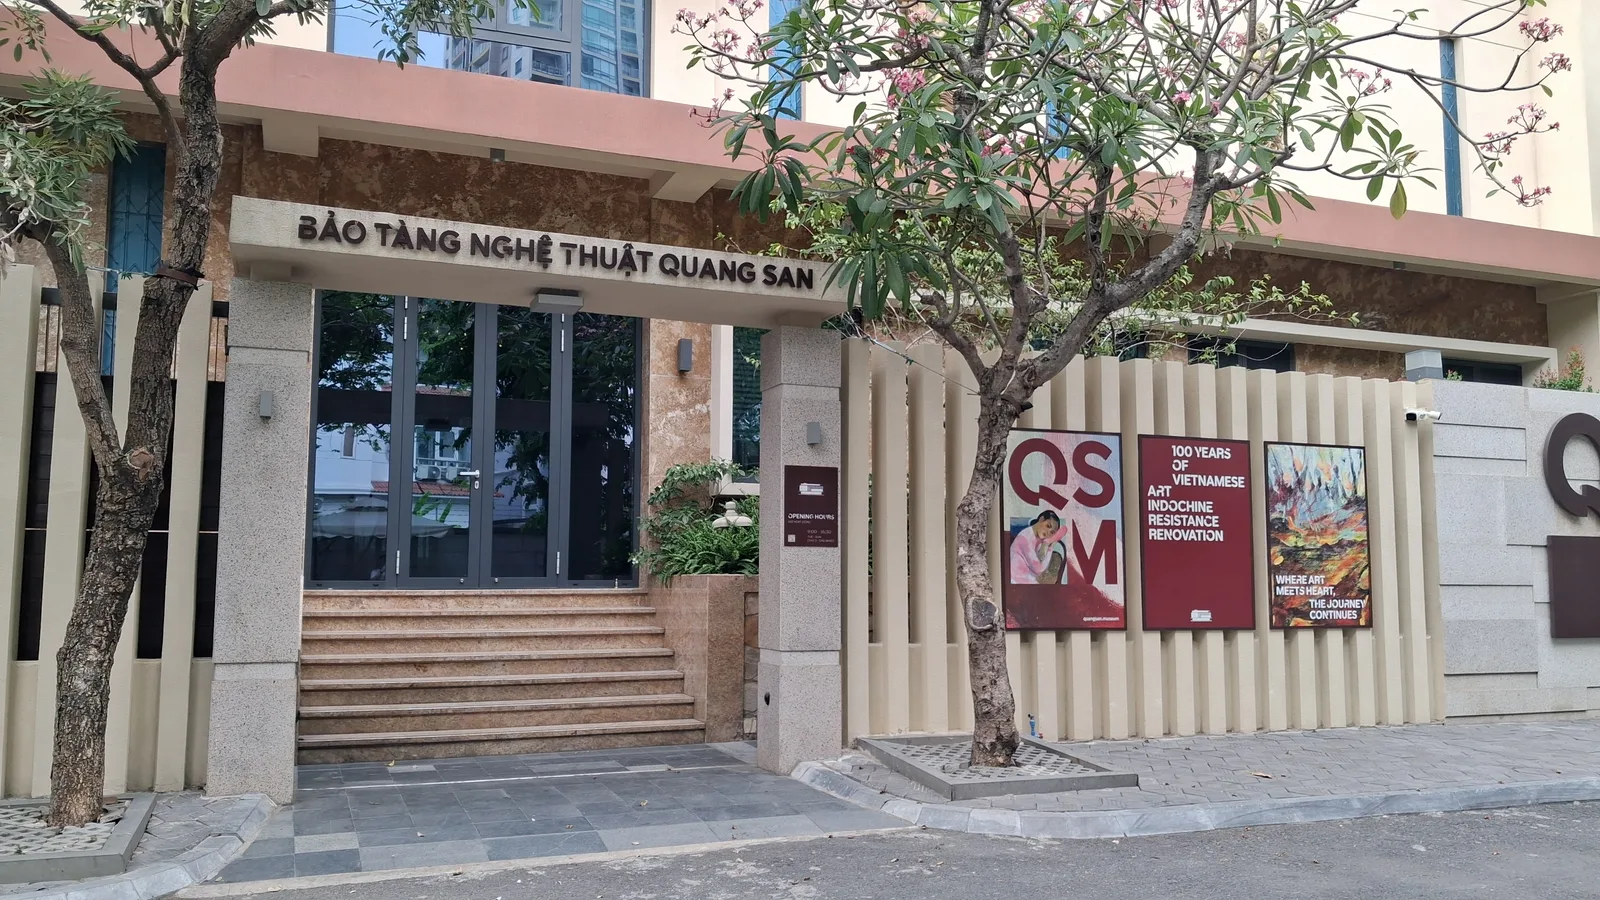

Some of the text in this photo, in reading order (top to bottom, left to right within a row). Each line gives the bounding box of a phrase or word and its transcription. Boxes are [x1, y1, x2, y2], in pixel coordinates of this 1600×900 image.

[297, 210, 813, 289] BẢO TÀNG NGHỆ THUẬT QUANG SAN
[1171, 445, 1232, 460] 100 YEARS
[1172, 459, 1189, 472] OF
[1008, 438, 1116, 511] QS
[1172, 473, 1246, 488] VIETNAMESE
[1147, 485, 1172, 497] ART
[1147, 499, 1214, 513] INDOCHINE
[814, 513, 835, 521] HOURS
[1148, 514, 1220, 527] RESISTANCE
[1148, 528, 1224, 542] RENOVATION
[1071, 518, 1118, 585] M
[1275, 575, 1325, 585] WHERE ART
[1275, 586, 1336, 597] MEETS HEART,
[1309, 599, 1366, 609] THE JOURNEY
[1309, 610, 1358, 620] CONTINUES
